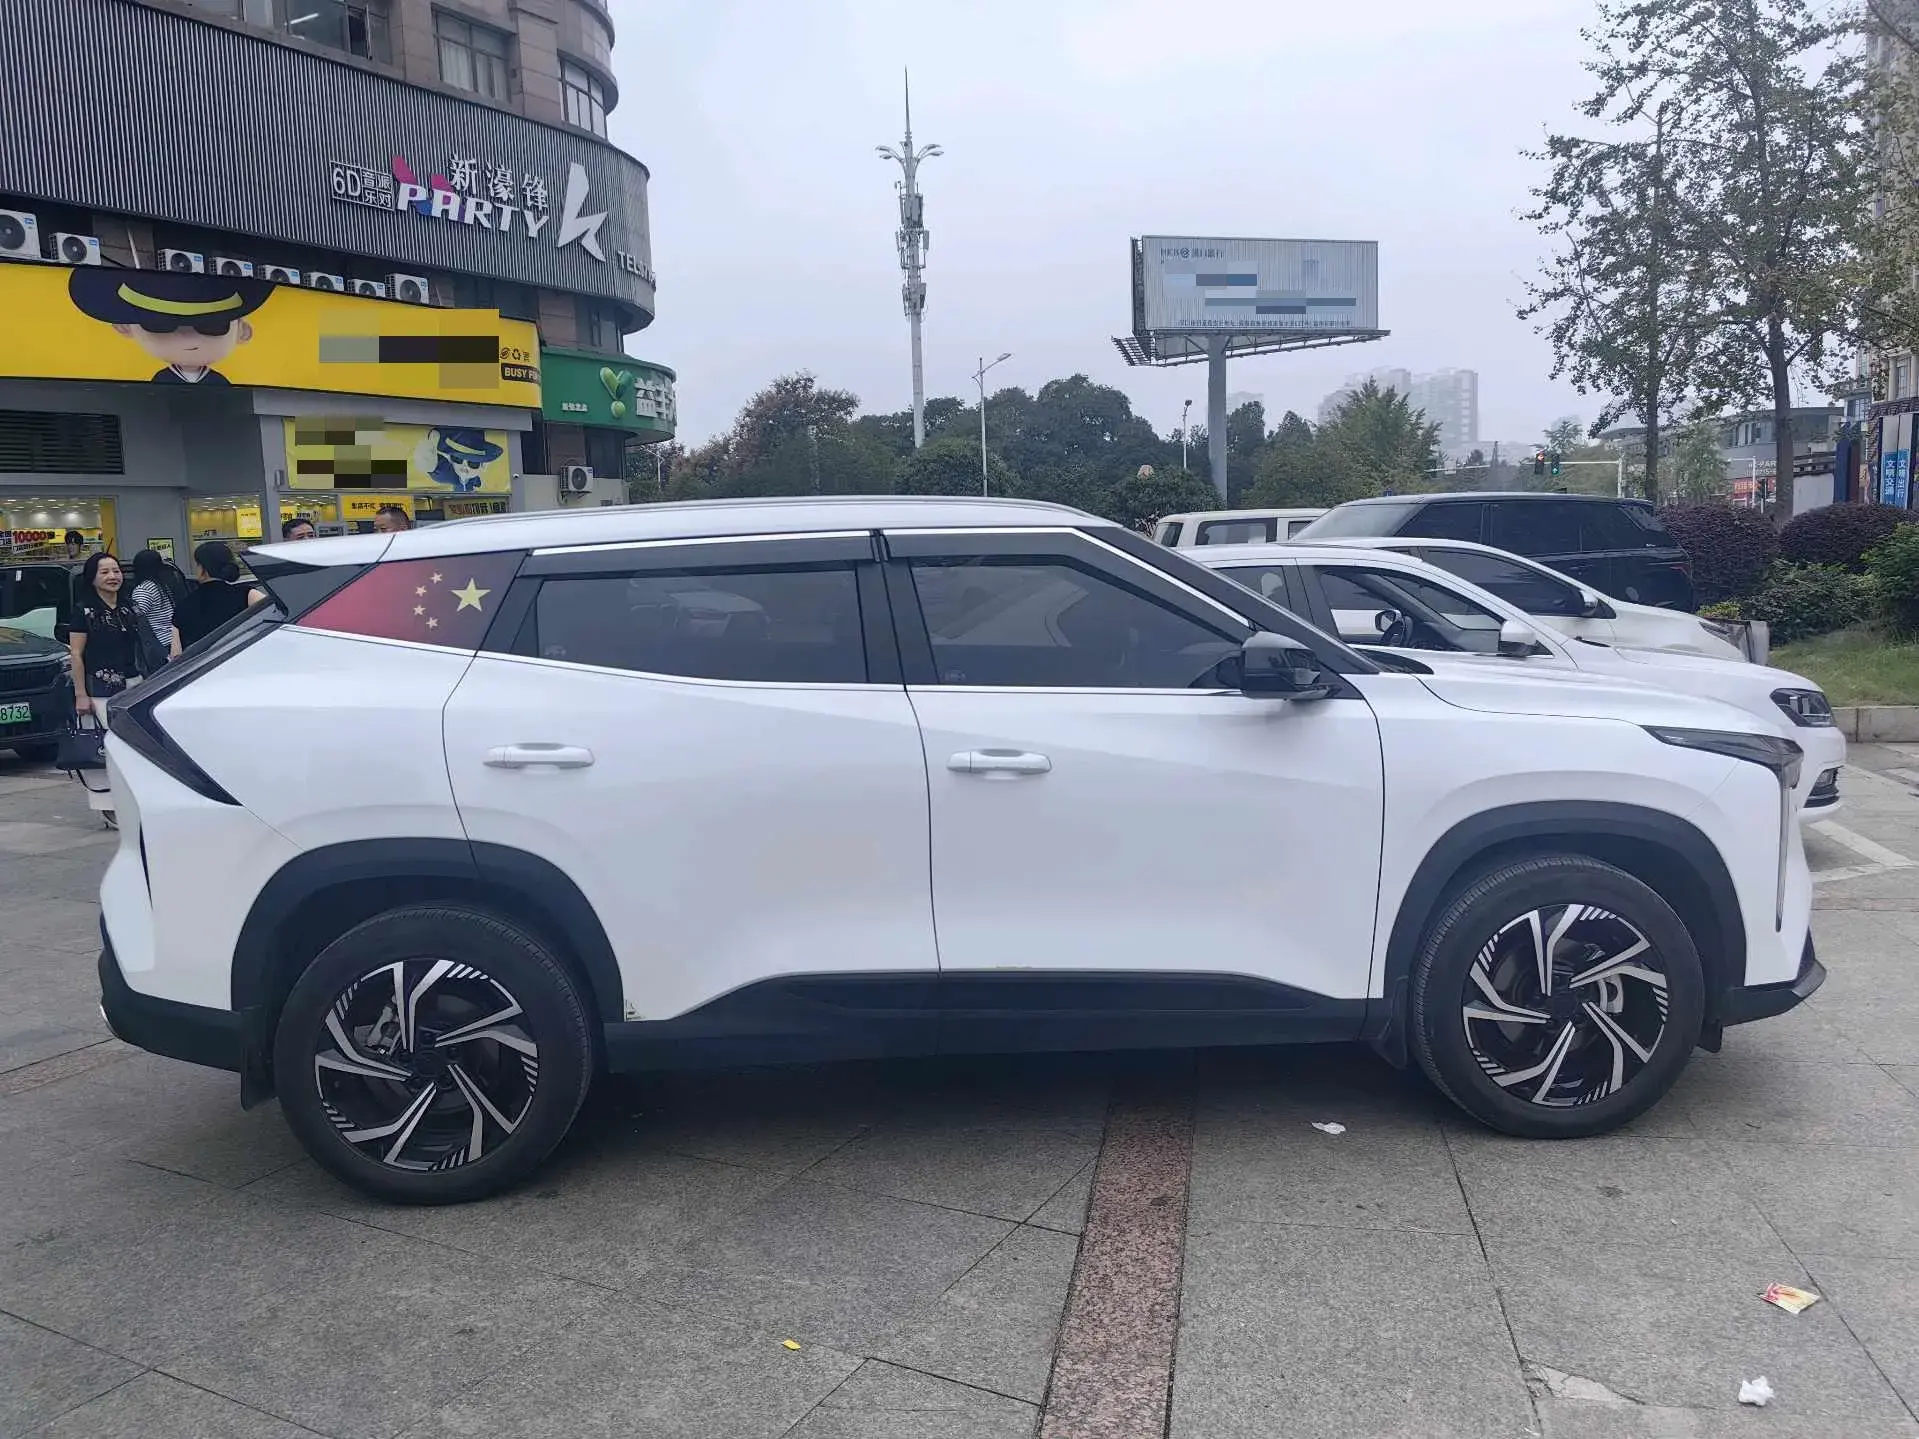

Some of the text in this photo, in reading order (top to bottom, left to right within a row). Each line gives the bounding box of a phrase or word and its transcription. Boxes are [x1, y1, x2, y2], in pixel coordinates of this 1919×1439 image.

[333, 167, 361, 196] 6D
[449, 153, 549, 211] 新濠锋
[397, 183, 550, 238] PARTY
[504, 367, 528, 378] BUSY
